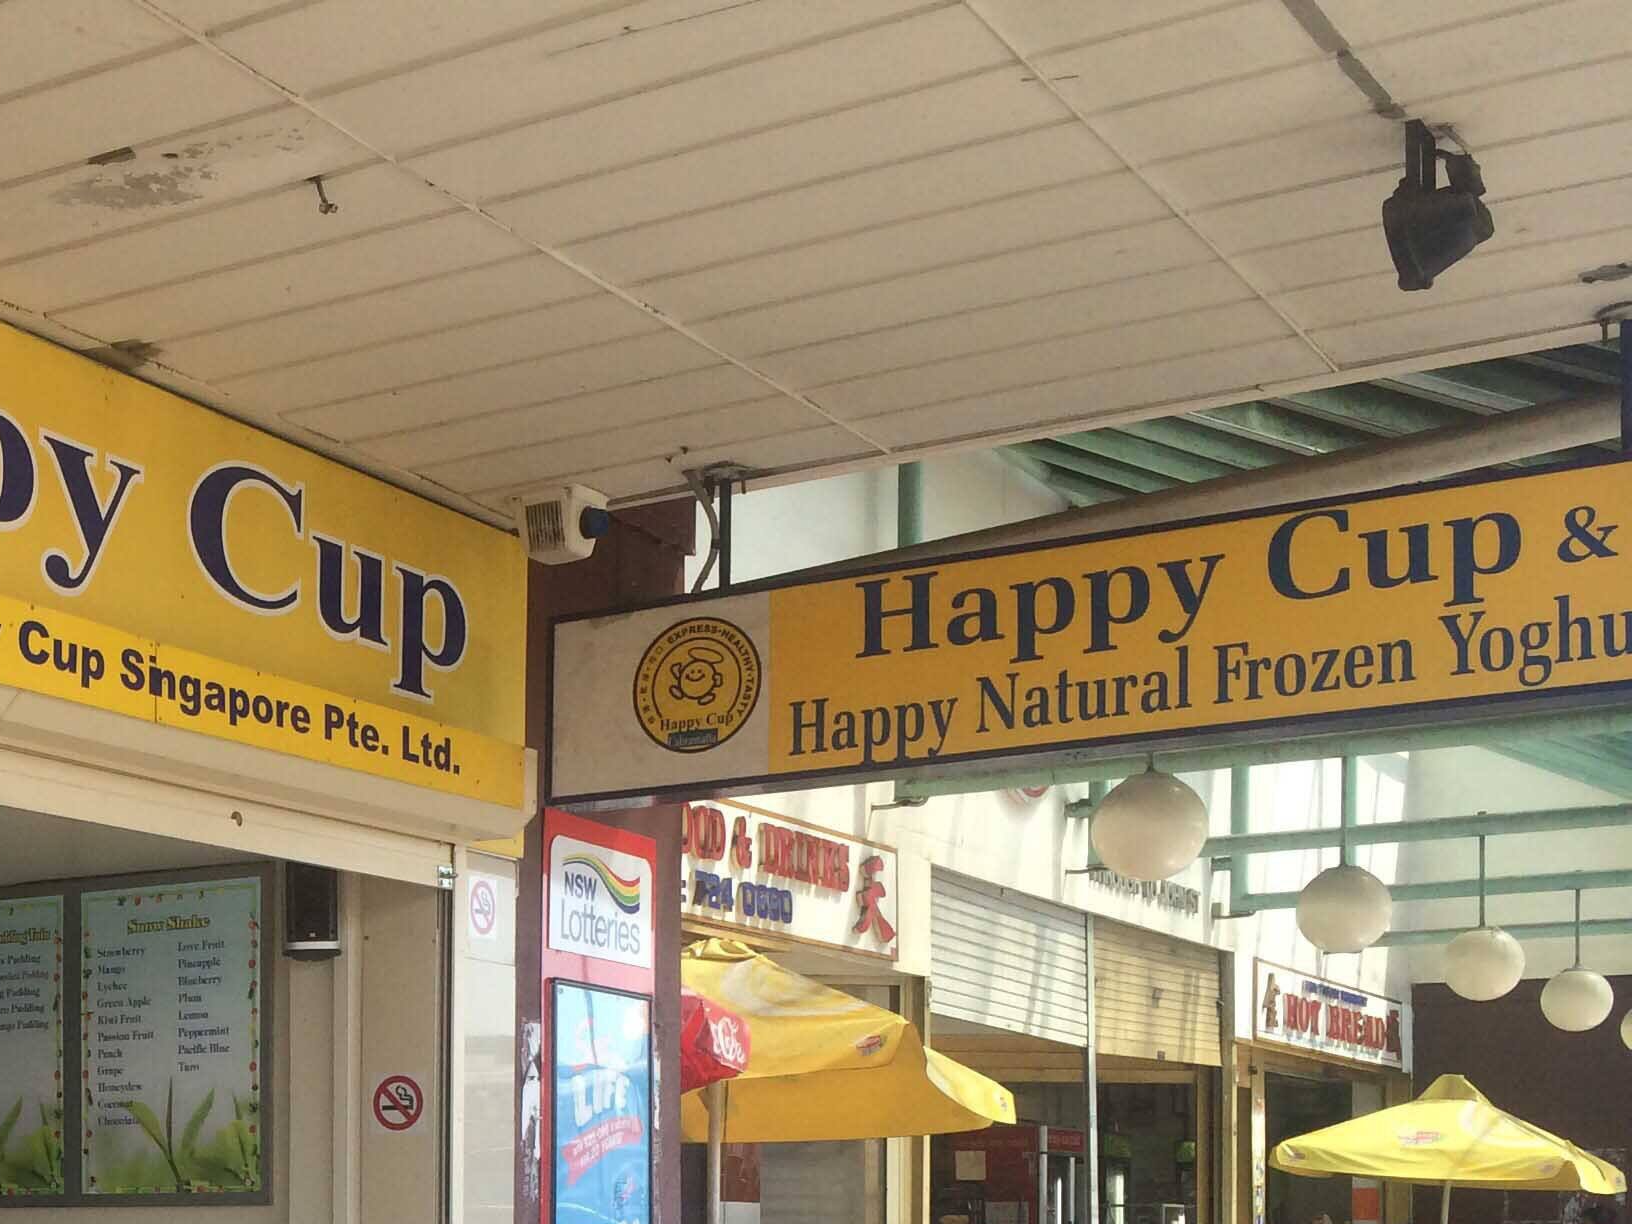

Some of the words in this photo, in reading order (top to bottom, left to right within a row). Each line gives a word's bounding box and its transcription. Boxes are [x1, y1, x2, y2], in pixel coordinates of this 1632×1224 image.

[188, 463, 469, 700] Cup
[855, 553, 1226, 665] Happy
[1267, 508, 1523, 607] Cup
[1557, 505, 1619, 564] &
[17, 620, 105, 694] Cup
[120, 649, 311, 743] Singapore
[324, 702, 391, 767] Pte.
[401, 723, 462, 786] Ltd.
[660, 717, 703, 732] Happy
[706, 711, 734, 727] Cup
[788, 697, 958, 766] Happy
[975, 644, 1193, 734] Natural
[1212, 637, 1416, 705] Frozen
[564, 870, 597, 901] NSW
[760, 824, 850, 892] DRINKS
[165, 913, 209, 930] Shake
[561, 899, 641, 954] Lotteries
[1284, 994, 1321, 1036] HOT
